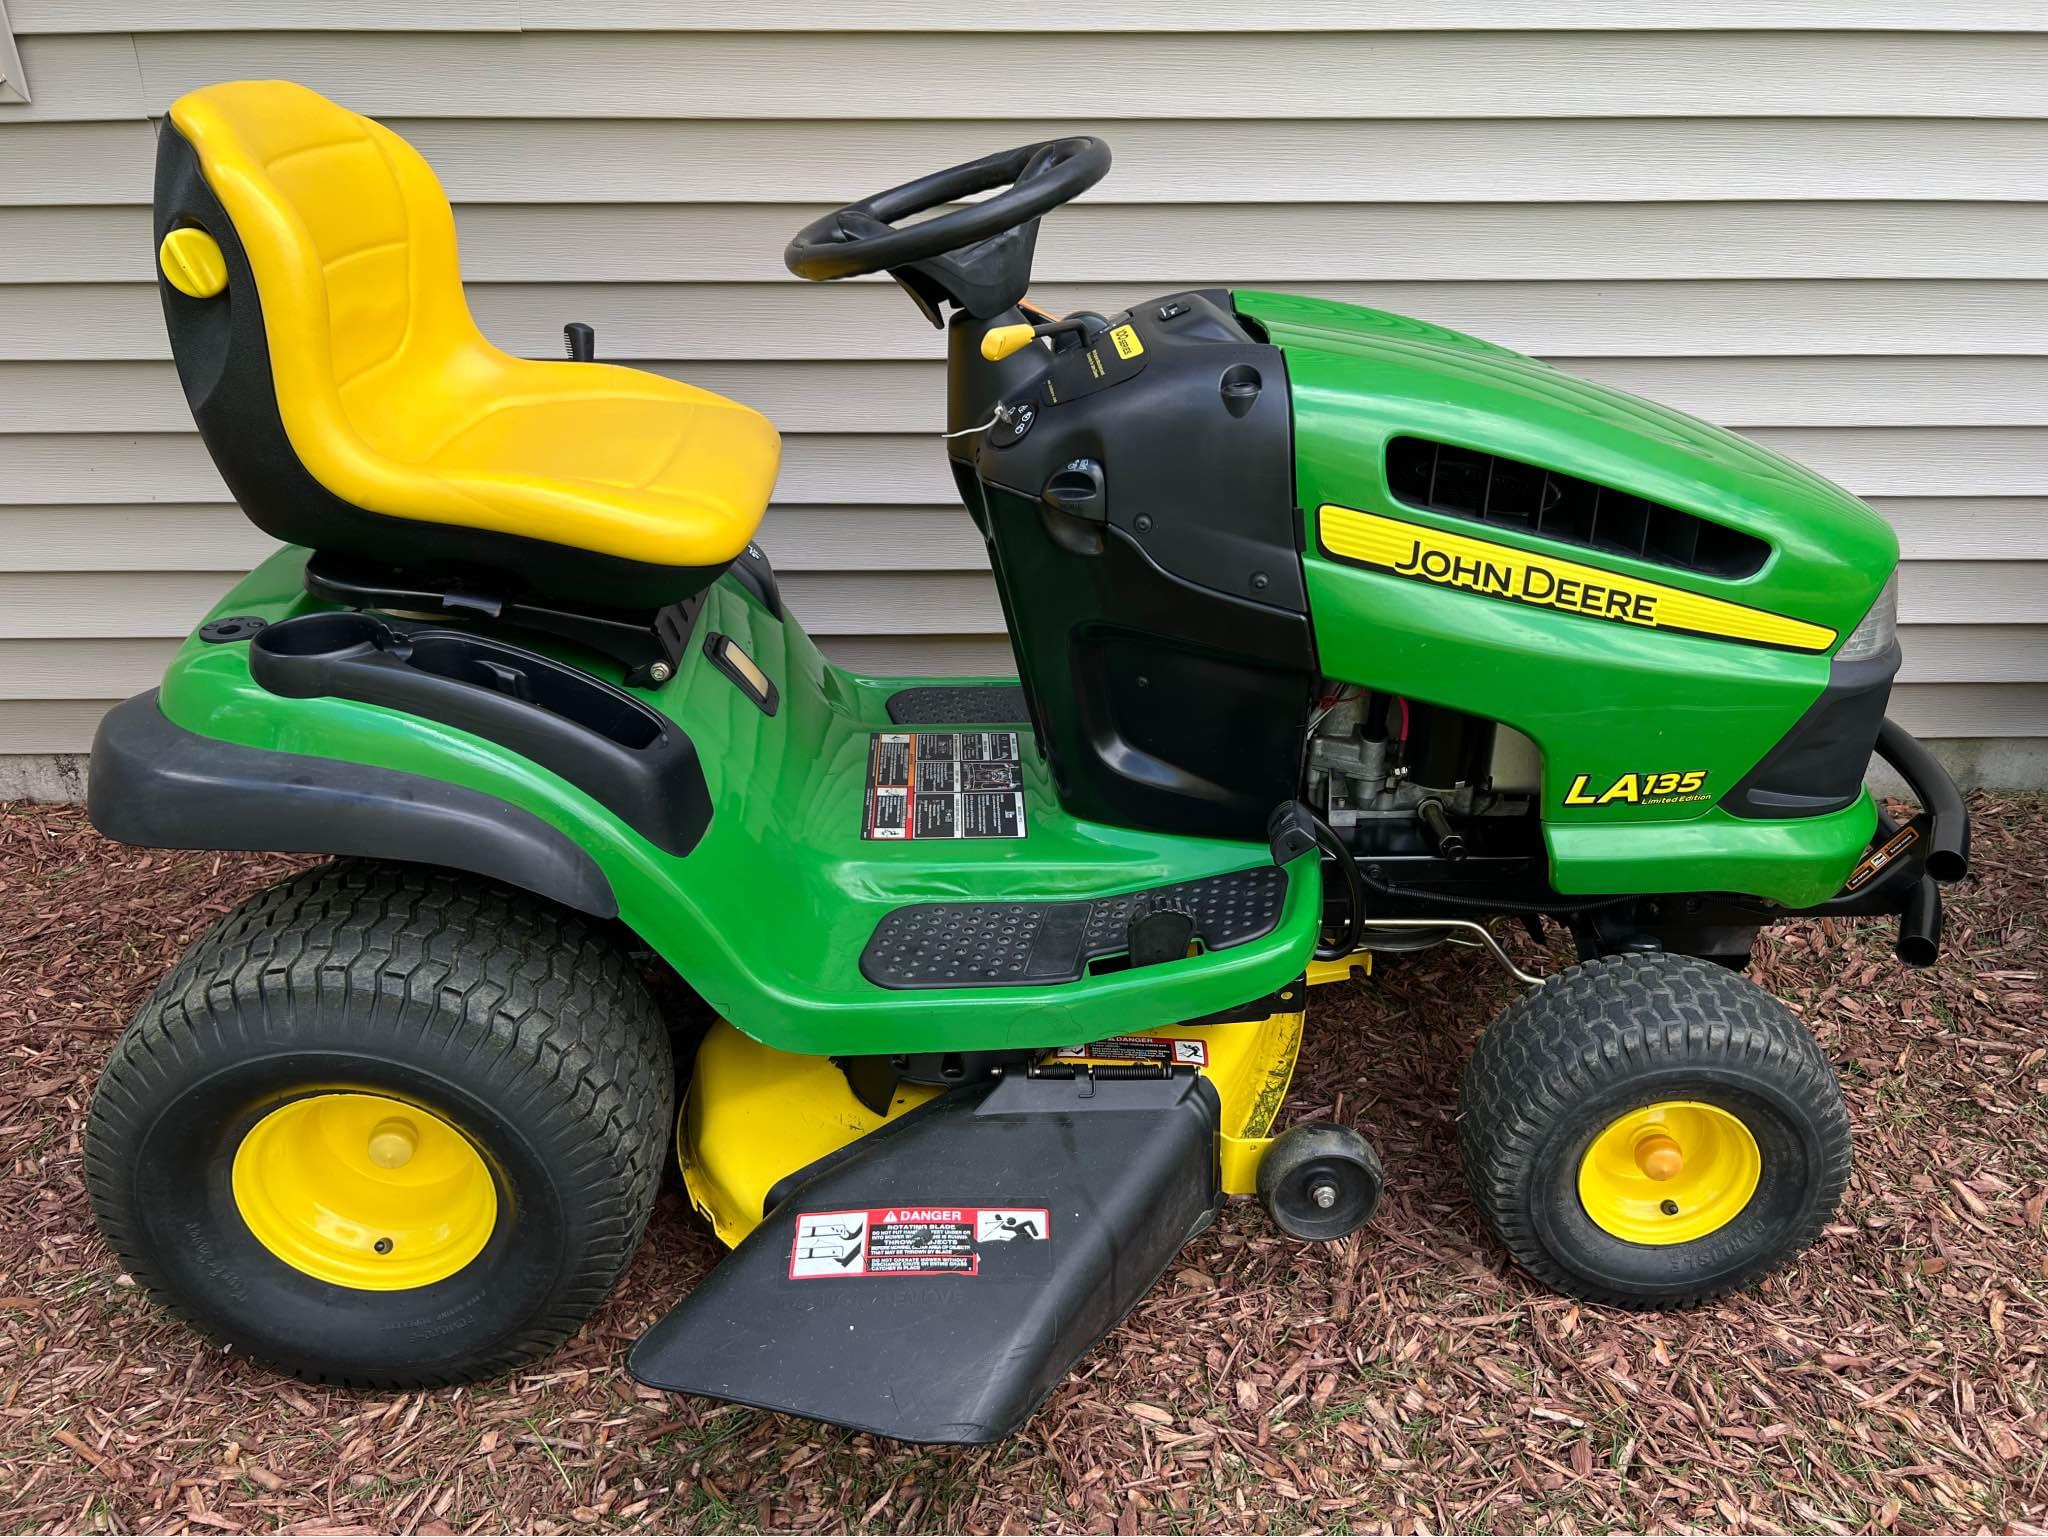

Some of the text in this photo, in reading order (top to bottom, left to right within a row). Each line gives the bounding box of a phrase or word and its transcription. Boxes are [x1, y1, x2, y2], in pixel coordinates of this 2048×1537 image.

[1395, 540, 1658, 623] JOHN DEERE
[1641, 796, 1679, 805] Limited
[900, 1211, 961, 1221] DANGER
